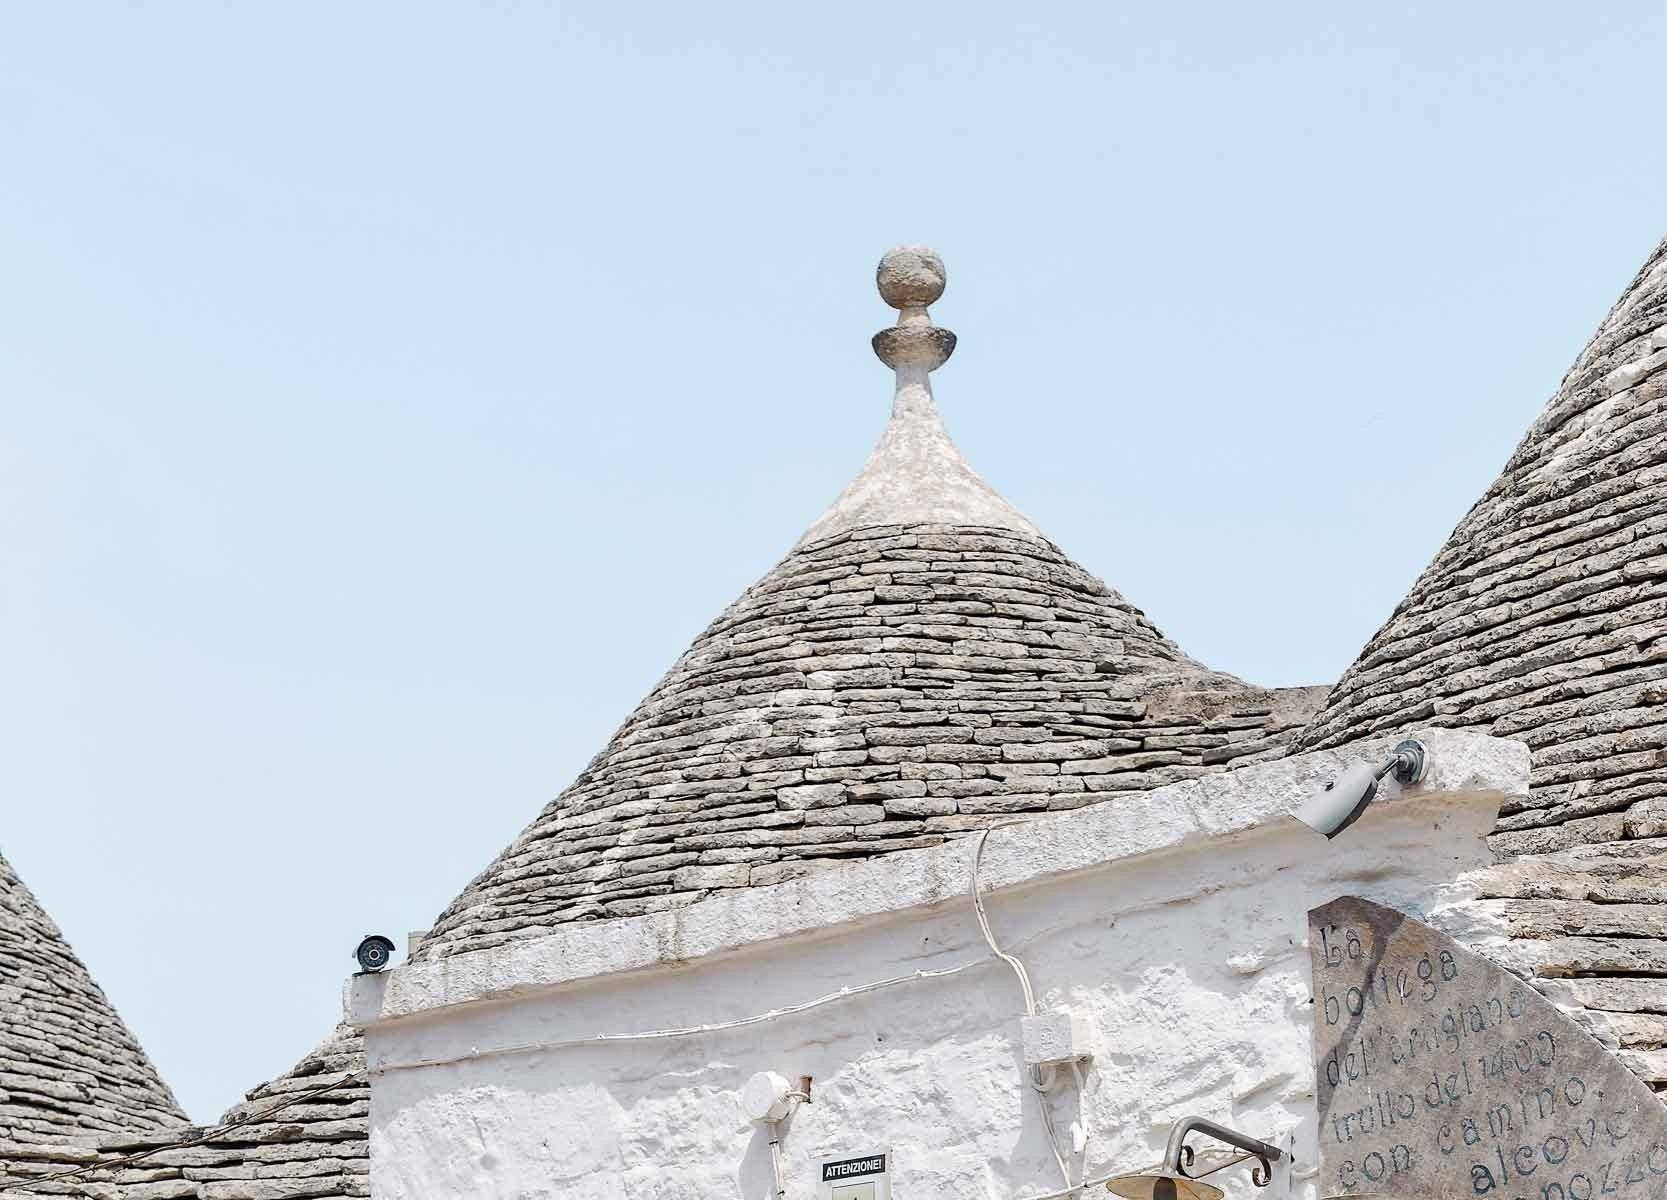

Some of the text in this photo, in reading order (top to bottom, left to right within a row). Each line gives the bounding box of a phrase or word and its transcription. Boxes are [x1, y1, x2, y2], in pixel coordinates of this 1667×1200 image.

[1322, 950, 1458, 1025] bottega
[1424, 1061, 1472, 1108] del
[825, 1158, 883, 1179] ATTENZIONE!
[1338, 1144, 1411, 1188] con
[1470, 1111, 1631, 1195] alcove
